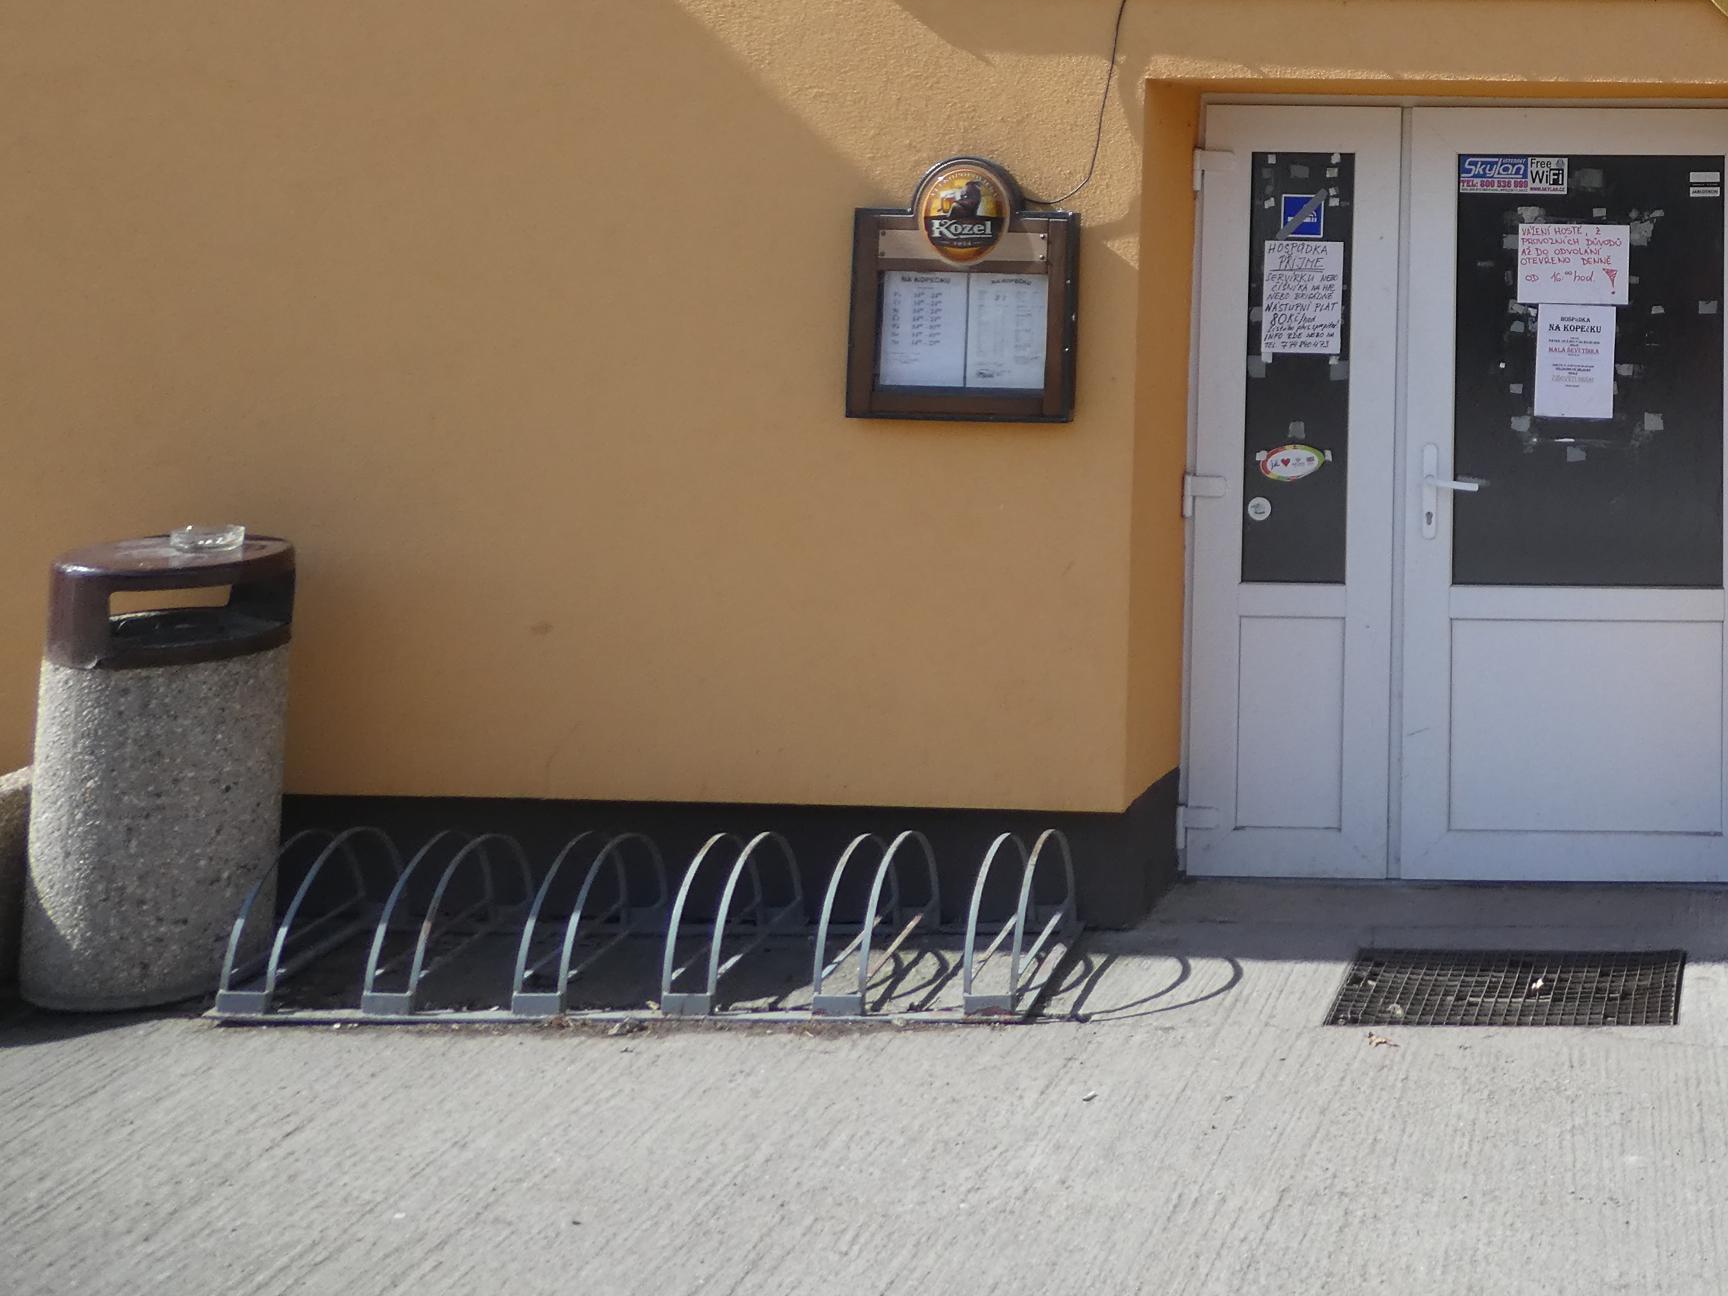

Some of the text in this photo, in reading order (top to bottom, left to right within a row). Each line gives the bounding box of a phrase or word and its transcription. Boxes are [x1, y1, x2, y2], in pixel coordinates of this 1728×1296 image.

[1530, 158, 1552, 169] Free
[1530, 169, 1565, 186] WiFi
[1461, 179, 1478, 188] TEL:
[931, 219, 992, 239] Kozel
[1536, 247, 1549, 256] DO
[1525, 274, 1540, 282] OD
